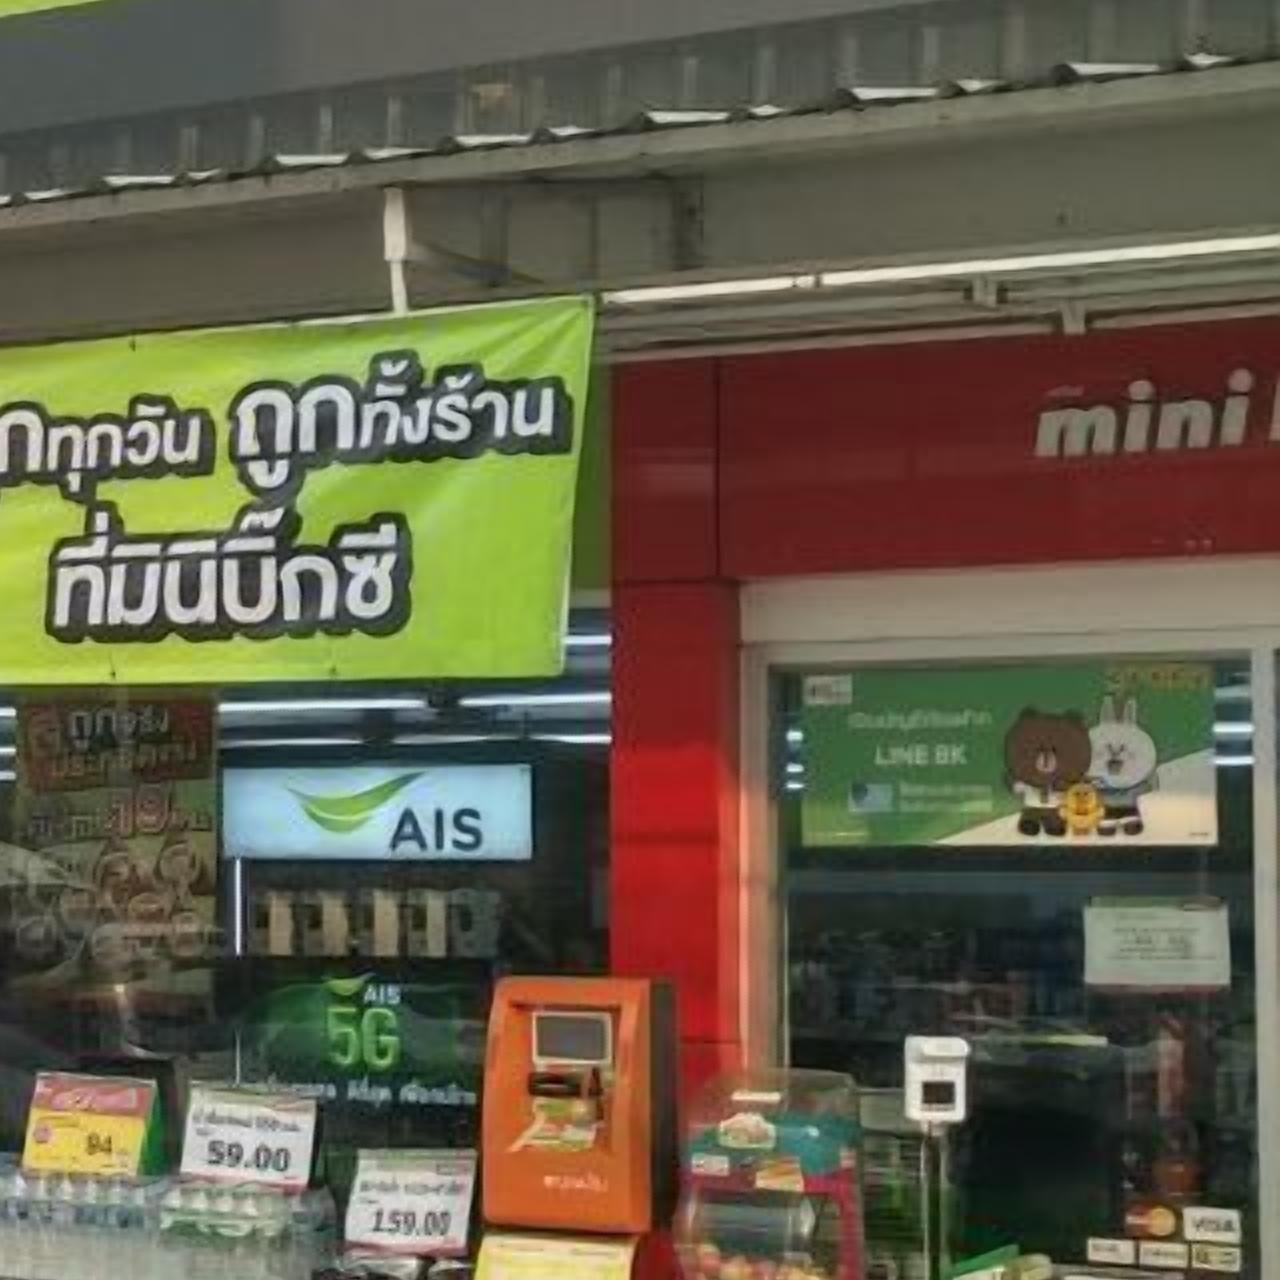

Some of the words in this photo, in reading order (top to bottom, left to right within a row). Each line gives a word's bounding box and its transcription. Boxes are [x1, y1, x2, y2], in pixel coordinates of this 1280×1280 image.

[237, 358, 554, 489] ถูกทั้งร้าน
[1034, 368, 1252, 457] mini
[54, 507, 397, 628] ที่มินิบิ๊กซี
[389, 808, 483, 852] AIS
[363, 985, 402, 1005] AIS
[326, 1005, 403, 1070] 5G
[207, 1139, 290, 1172] 59.00
[372, 1208, 452, 1237] 159.00
